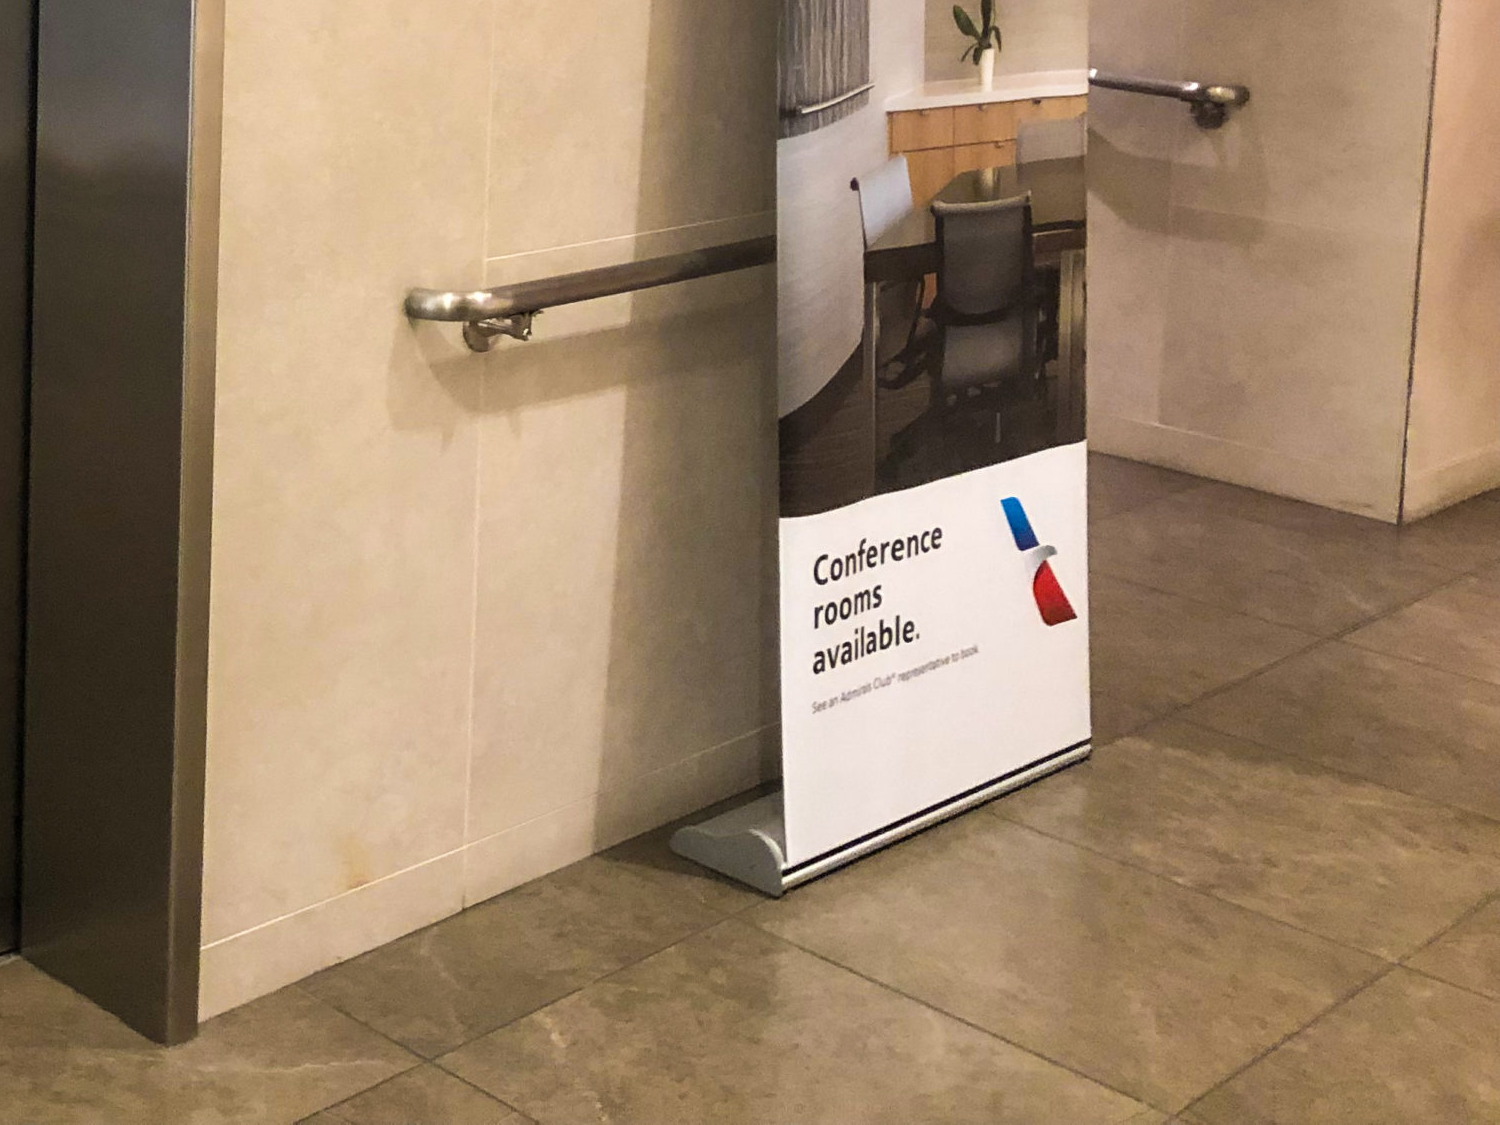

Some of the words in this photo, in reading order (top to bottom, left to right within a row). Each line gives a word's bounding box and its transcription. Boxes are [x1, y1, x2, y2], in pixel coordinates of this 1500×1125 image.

[812, 526, 943, 586] Conference
[813, 584, 882, 630] rooms
[812, 615, 920, 675] available.
[811, 701, 828, 715] See
[828, 696, 839, 709] an
[950, 652, 960, 664] to
